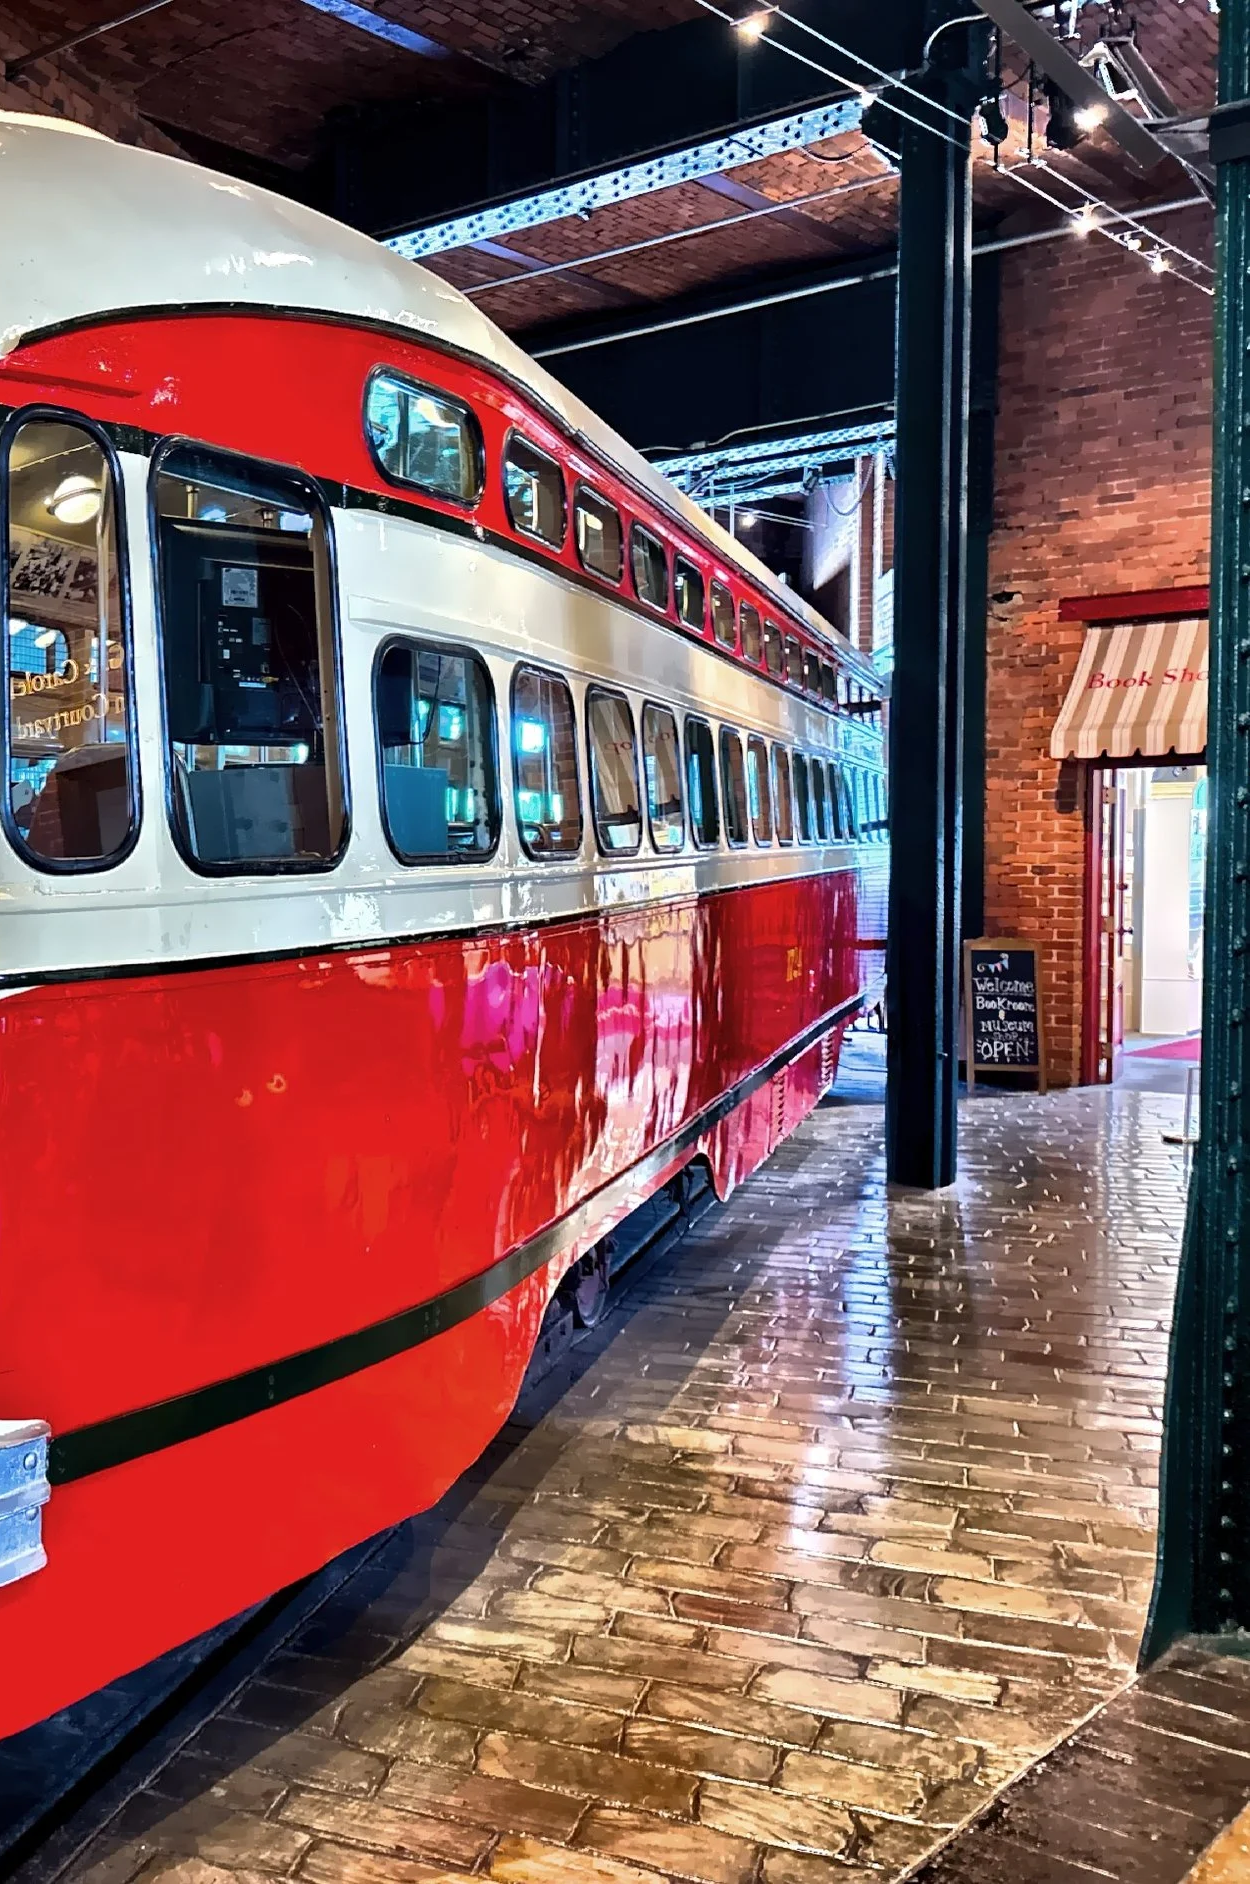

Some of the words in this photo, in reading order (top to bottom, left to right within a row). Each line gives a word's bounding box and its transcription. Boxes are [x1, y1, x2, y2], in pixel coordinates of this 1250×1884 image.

[1088, 671, 1153, 689] Book
[1162, 667, 1209, 684] Sho
[972, 977, 1035, 993] Welcome
[981, 1041, 1029, 1058] OPEN
